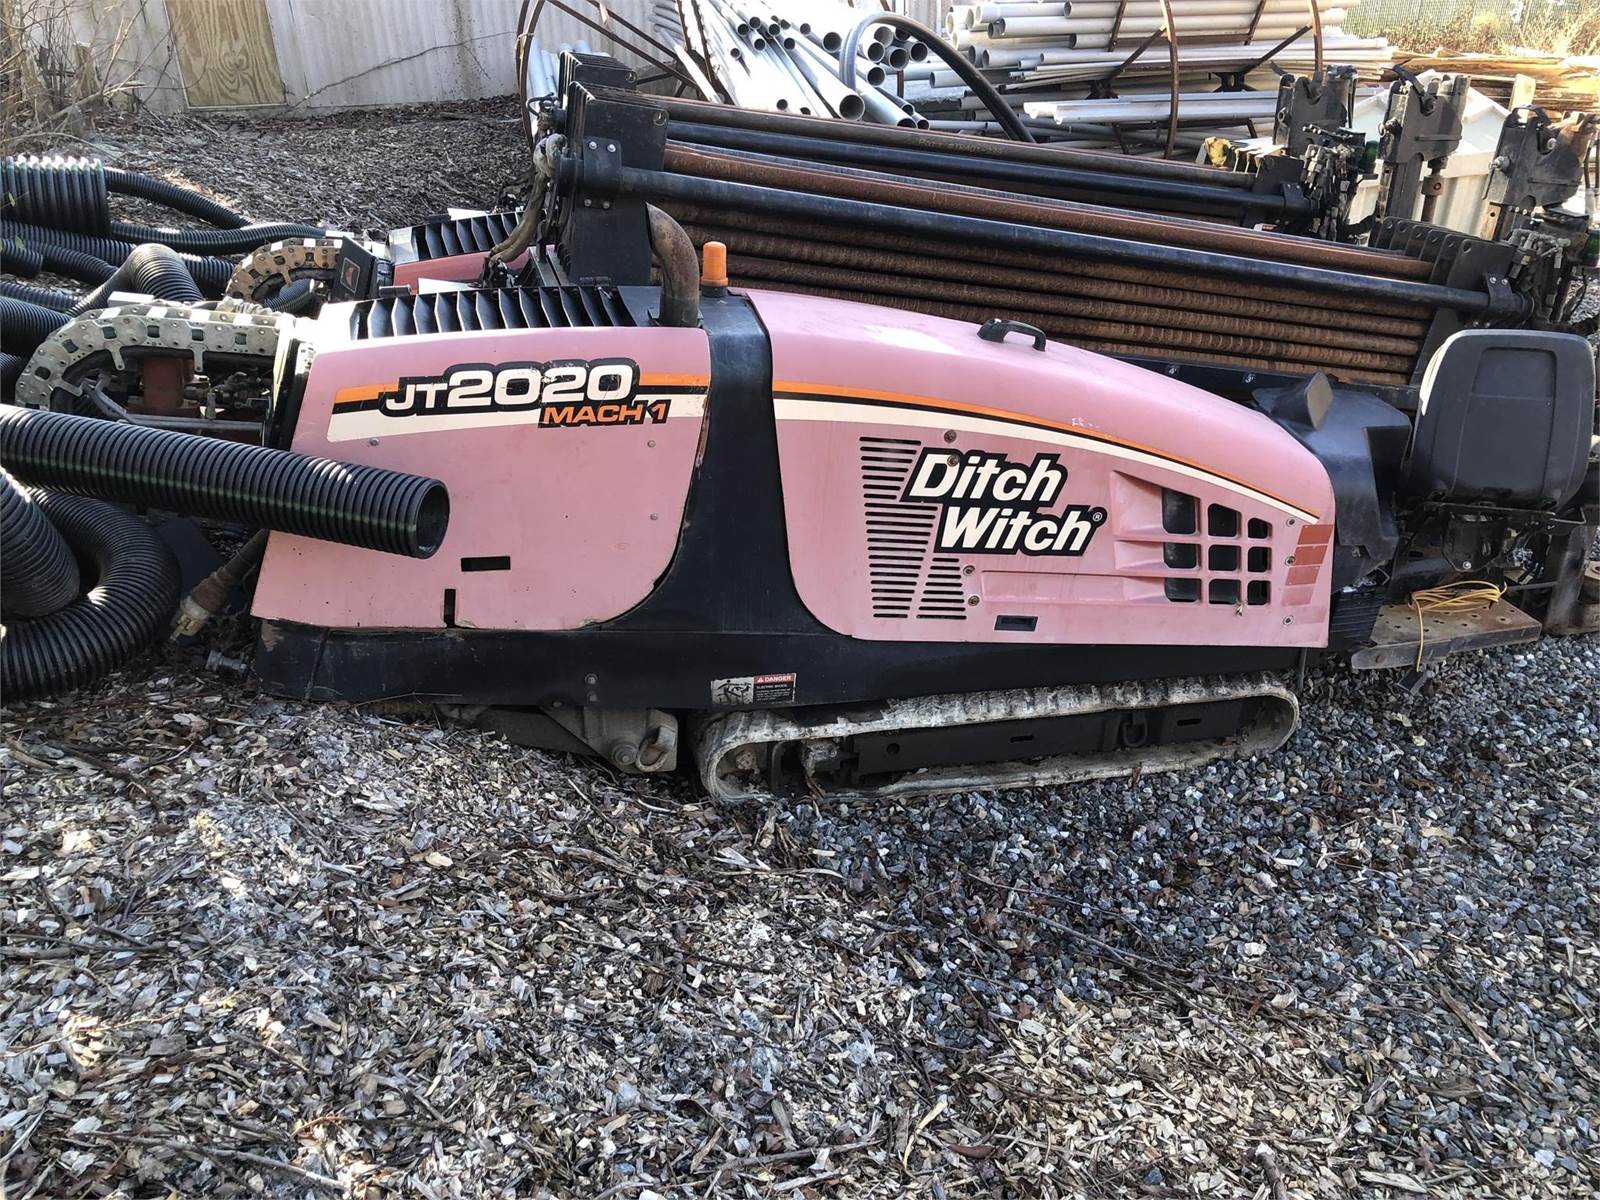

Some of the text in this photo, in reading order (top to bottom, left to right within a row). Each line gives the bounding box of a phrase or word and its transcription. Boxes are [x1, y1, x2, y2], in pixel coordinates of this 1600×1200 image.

[386, 364, 634, 411] JT2020
[543, 402, 667, 424] MACH 1
[909, 453, 1063, 502] Ditch
